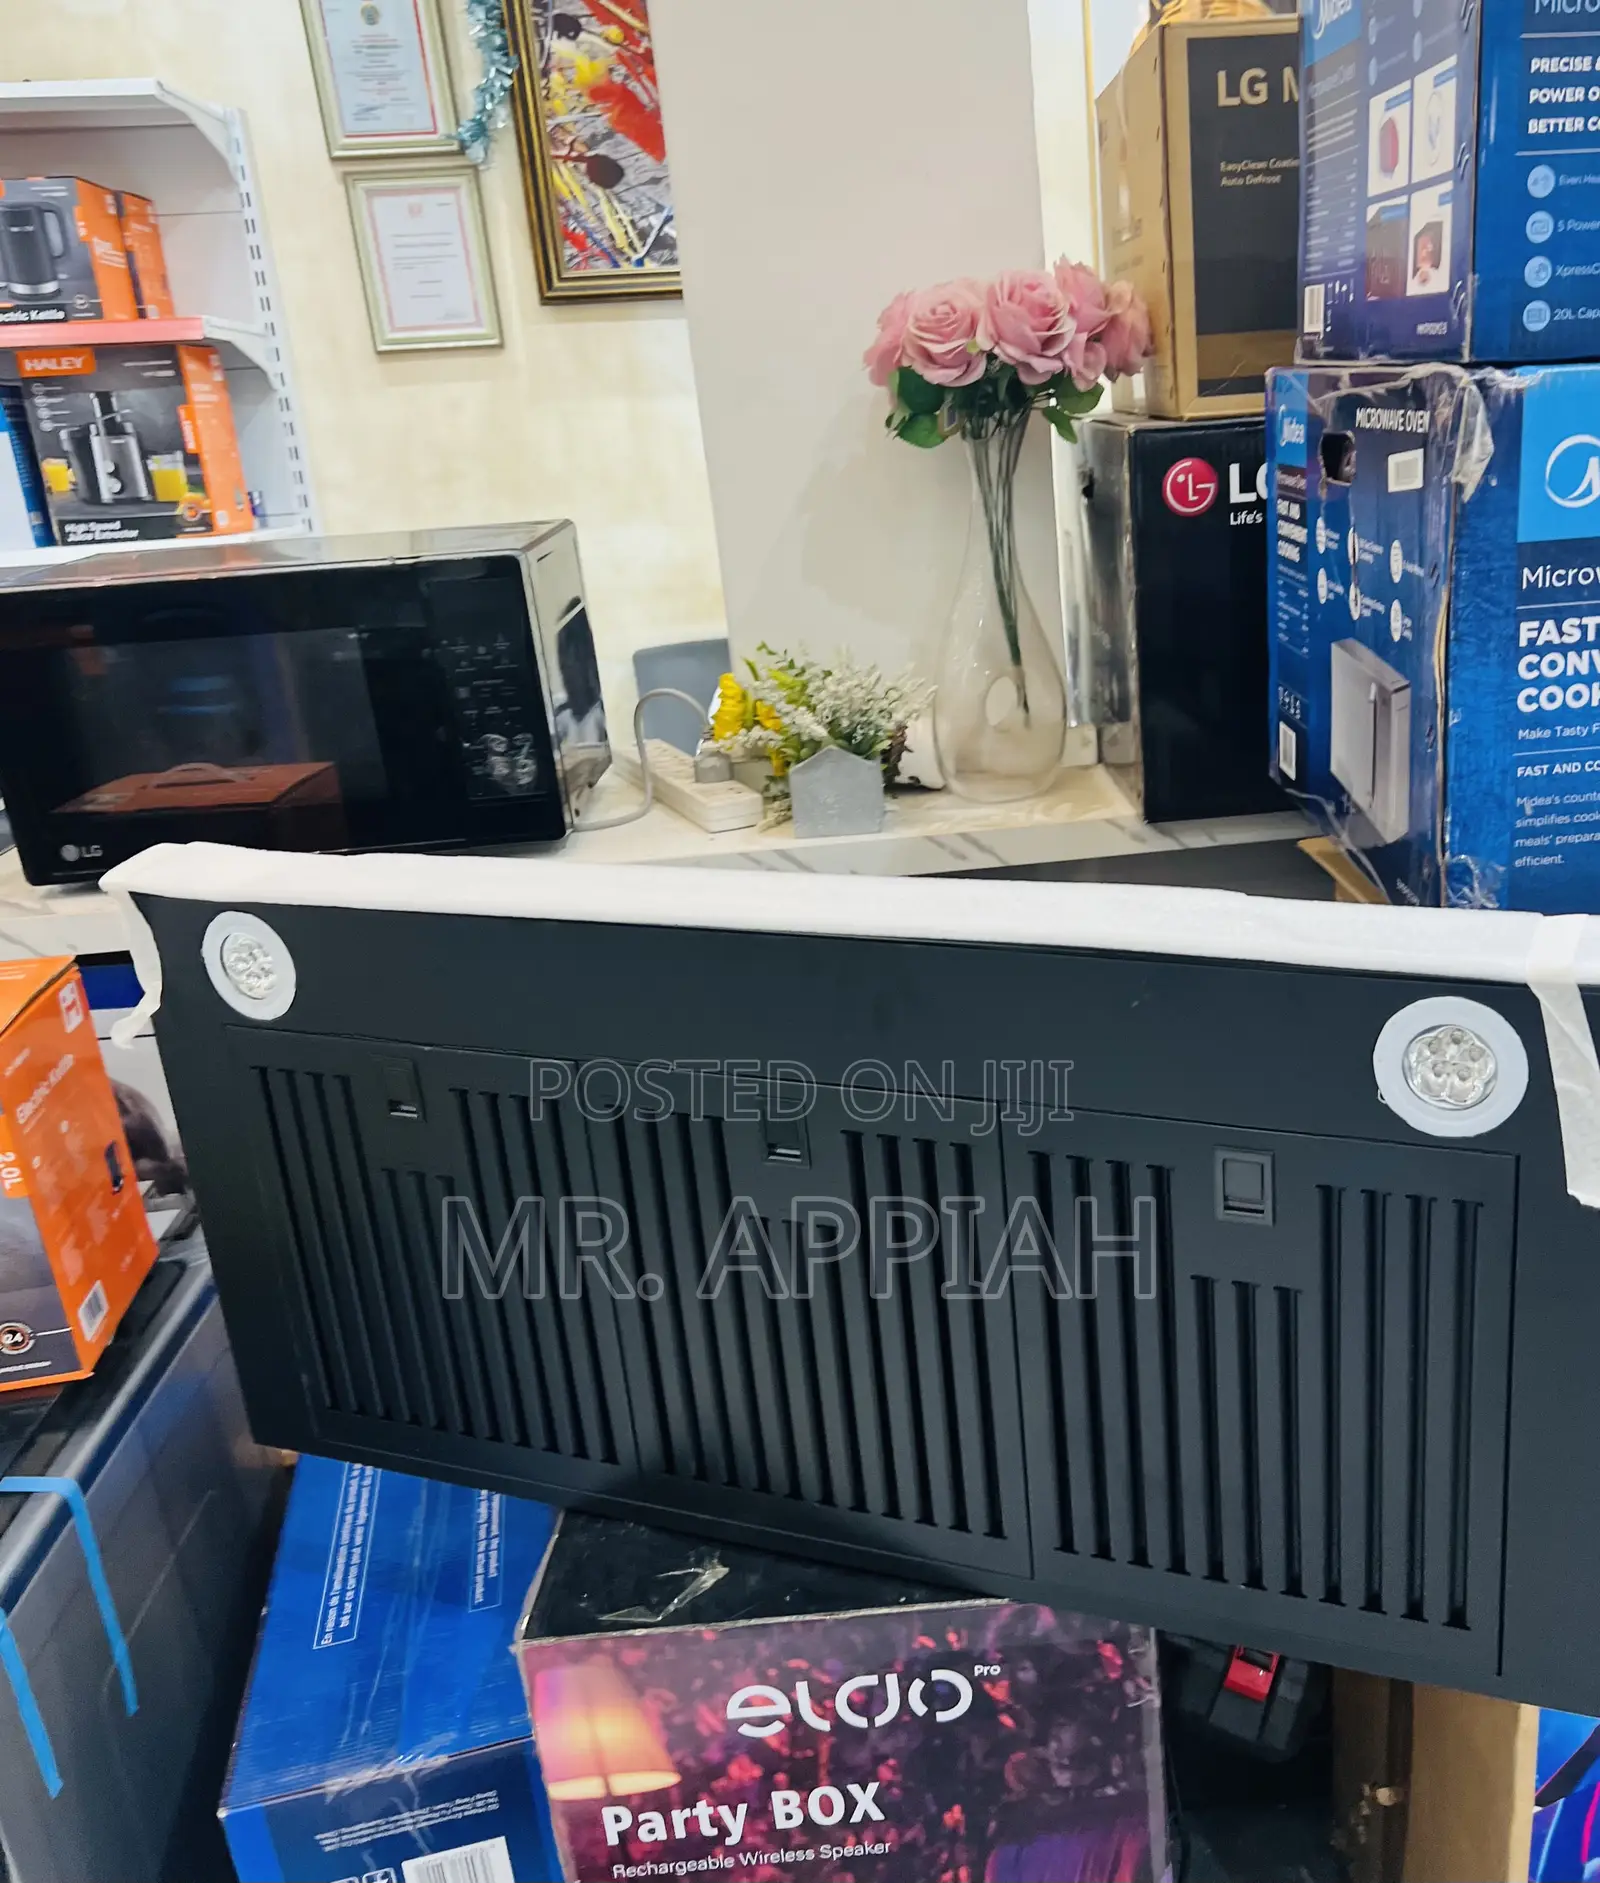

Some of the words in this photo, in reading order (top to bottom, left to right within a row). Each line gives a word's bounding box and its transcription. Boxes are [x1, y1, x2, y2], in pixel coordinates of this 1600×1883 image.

[1530, 56, 1593, 74] PRECISE
[1217, 67, 1268, 107] LG
[1529, 86, 1585, 104] POWER
[1528, 117, 1585, 134] BETTER
[1554, 307, 1574, 321] 20L
[24, 357, 83, 371] HALEY
[1356, 407, 1404, 432] MICROWAVE
[1405, 409, 1430, 433] OVEN
[1230, 510, 1263, 525] Life's
[1522, 565, 1600, 590] Micro
[1519, 616, 1600, 647] FAST
[1518, 727, 1551, 740] Make
[1555, 723, 1589, 738] Tasty
[1517, 765, 1549, 777] FAST
[1552, 761, 1581, 775] AND
[1516, 793, 1560, 807] Midea's
[1515, 812, 1571, 828] simplifies
[973, 1664, 1001, 1677] Pro
[601, 1799, 748, 1847] Party
[771, 1782, 886, 1830] BOX
[613, 1853, 734, 1879] Rechargeable
[739, 1847, 815, 1867] Wireless
[819, 1840, 891, 1861] Speaker
